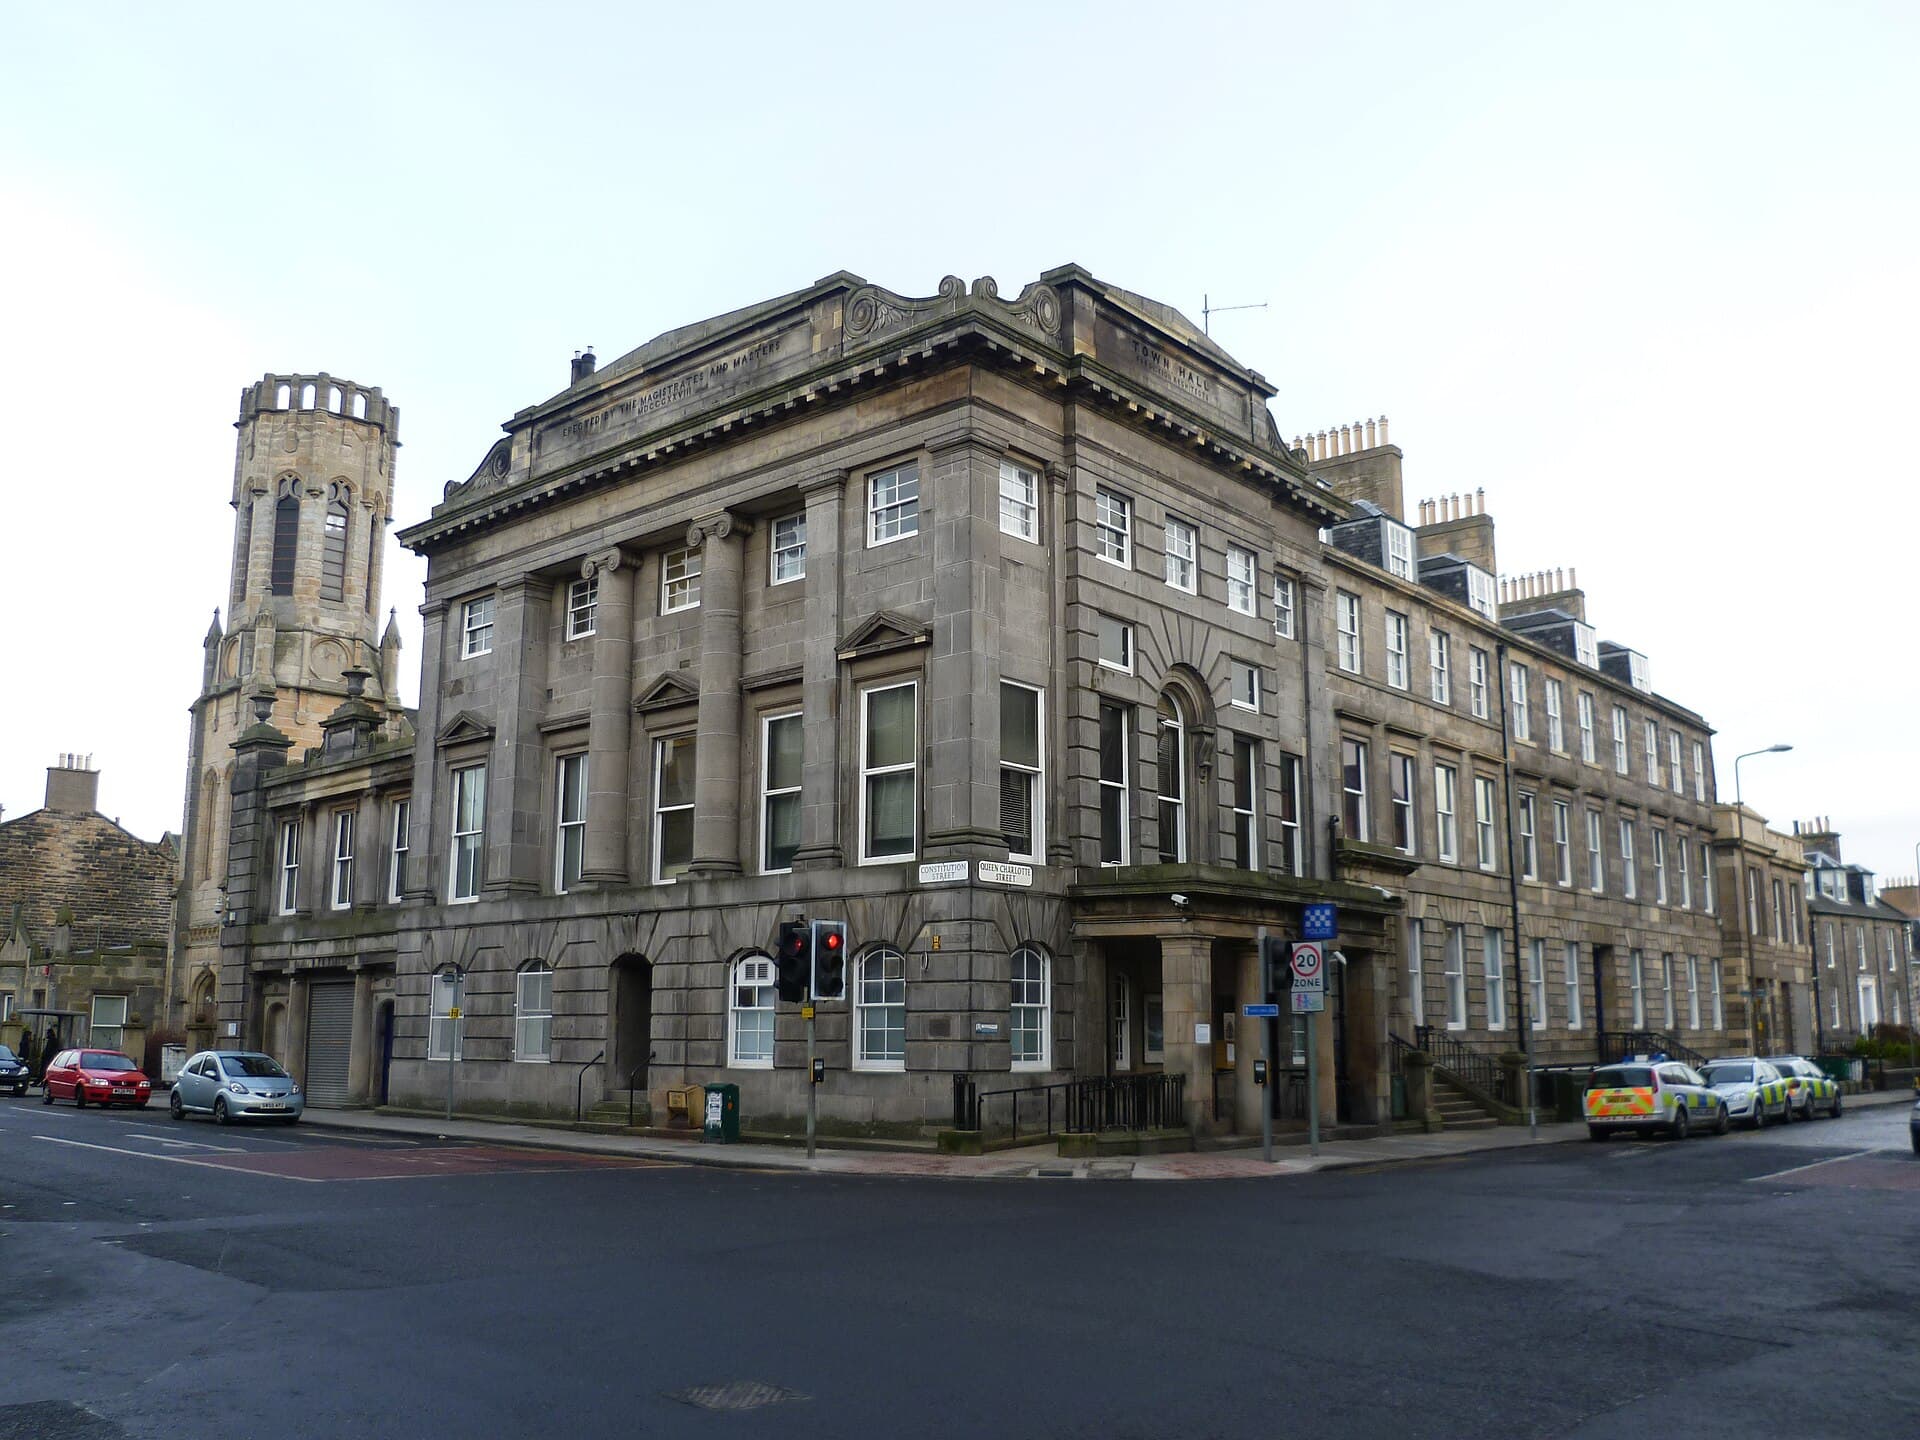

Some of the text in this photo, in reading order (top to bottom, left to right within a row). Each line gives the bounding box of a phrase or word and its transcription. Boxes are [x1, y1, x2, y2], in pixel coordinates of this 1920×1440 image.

[1131, 340, 1170, 369] TOWN
[1179, 365, 1209, 392] HALL
[619, 399, 637, 414] THE
[640, 372, 704, 406] MAGISTRATES
[710, 362, 729, 378] AND
[733, 341, 780, 369] MASTERS
[920, 863, 966, 874] CONSTITUTION
[980, 862, 1031, 877] QUEEN CHARLOTTE
[932, 872, 955, 880] STREET
[996, 874, 1016, 882] STREET
[1305, 927, 1331, 935] POLICE
[1296, 954, 1316, 967] 20
[1294, 977, 1320, 987] ZONE
